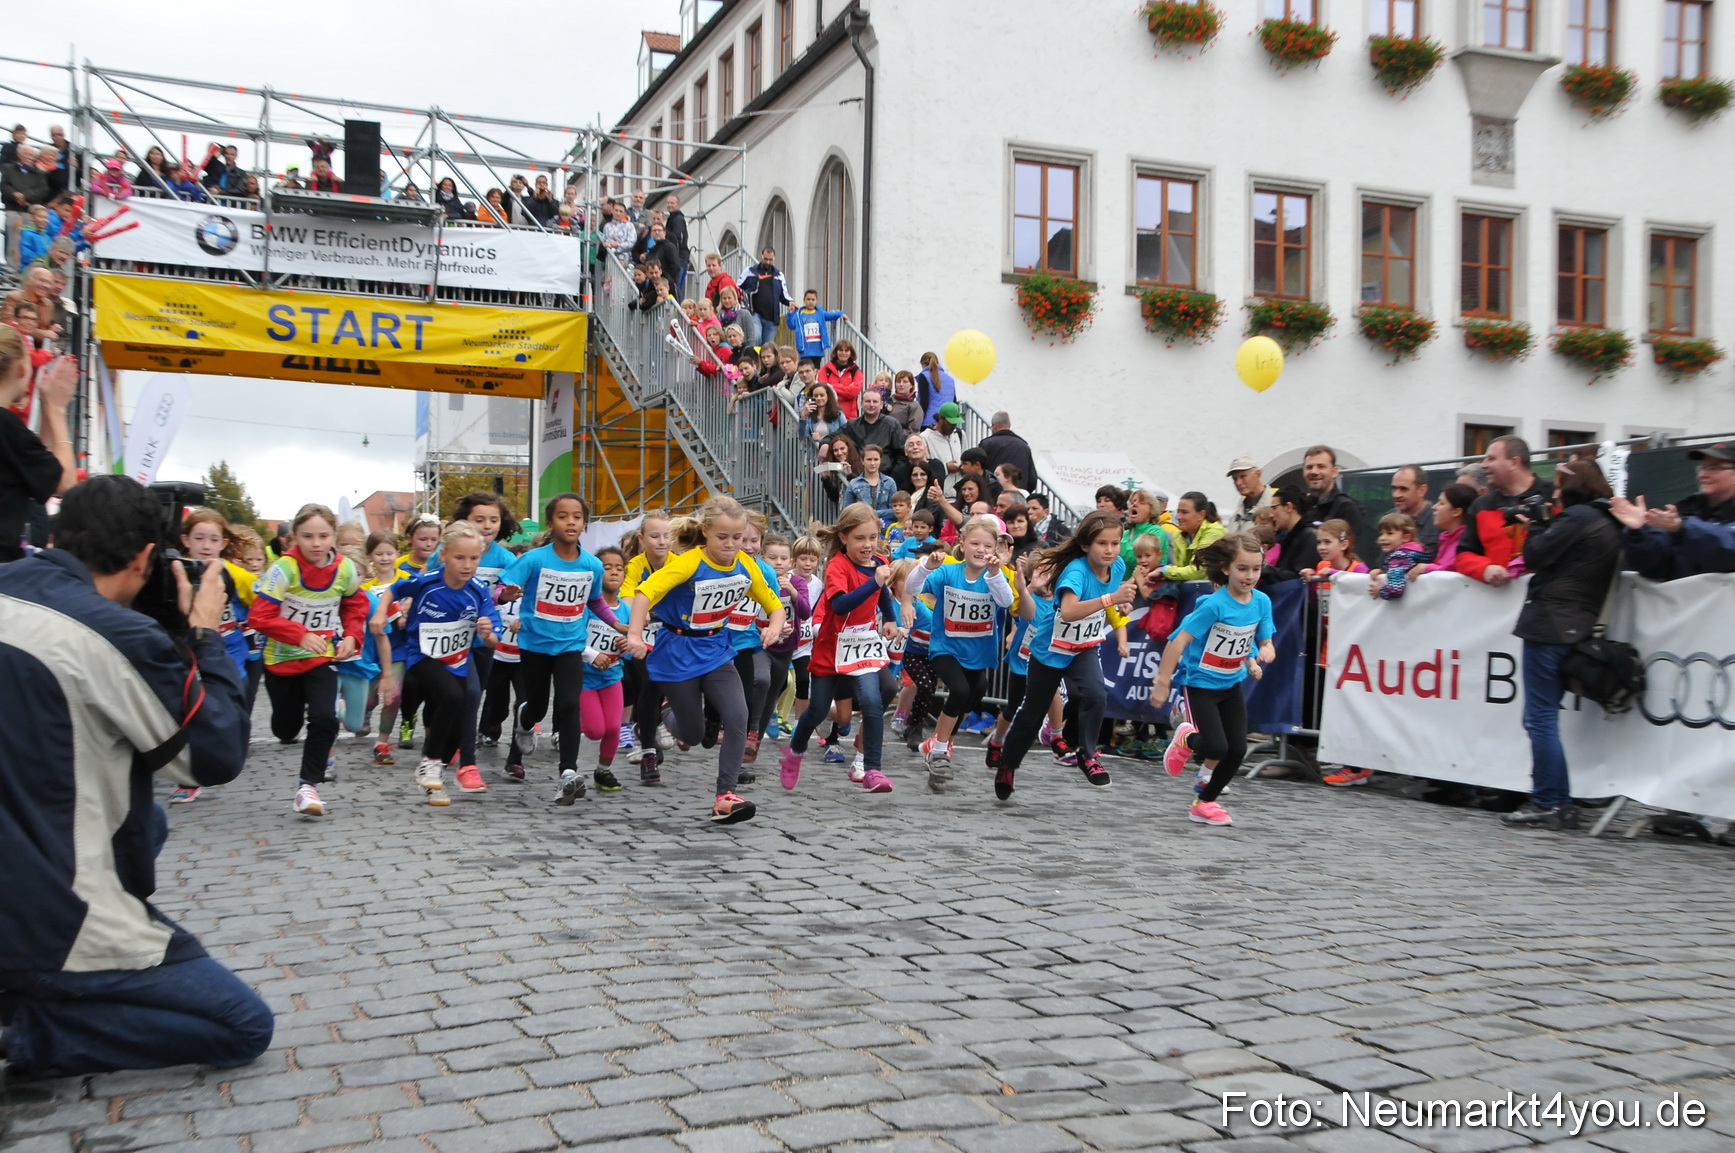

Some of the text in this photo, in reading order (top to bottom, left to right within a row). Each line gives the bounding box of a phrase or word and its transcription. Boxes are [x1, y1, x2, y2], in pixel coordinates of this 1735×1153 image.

[251, 224, 497, 260] BMW EfficientDynamics
[250, 244, 308, 261] Weniger
[311, 250, 383, 267] Verbrauch.
[387, 256, 426, 270] Mehr
[266, 303, 434, 351] START
[462, 338, 561, 352] Neumarkter Stadtlauf
[541, 573, 560, 581] PARTL
[697, 580, 744, 592] PARTL Neumarkt
[545, 582, 587, 603] 7504
[701, 587, 746, 611] 7203
[945, 590, 988, 603] PARTL Neumarkt
[287, 605, 333, 628] 7151
[948, 599, 991, 621] 7183
[1060, 620, 1102, 641] 7149
[1213, 625, 1232, 636] PARTL
[427, 630, 470, 656] 7083
[842, 641, 884, 662] 7123
[1213, 634, 1253, 656] 7139
[1335, 643, 1460, 701] Audi
